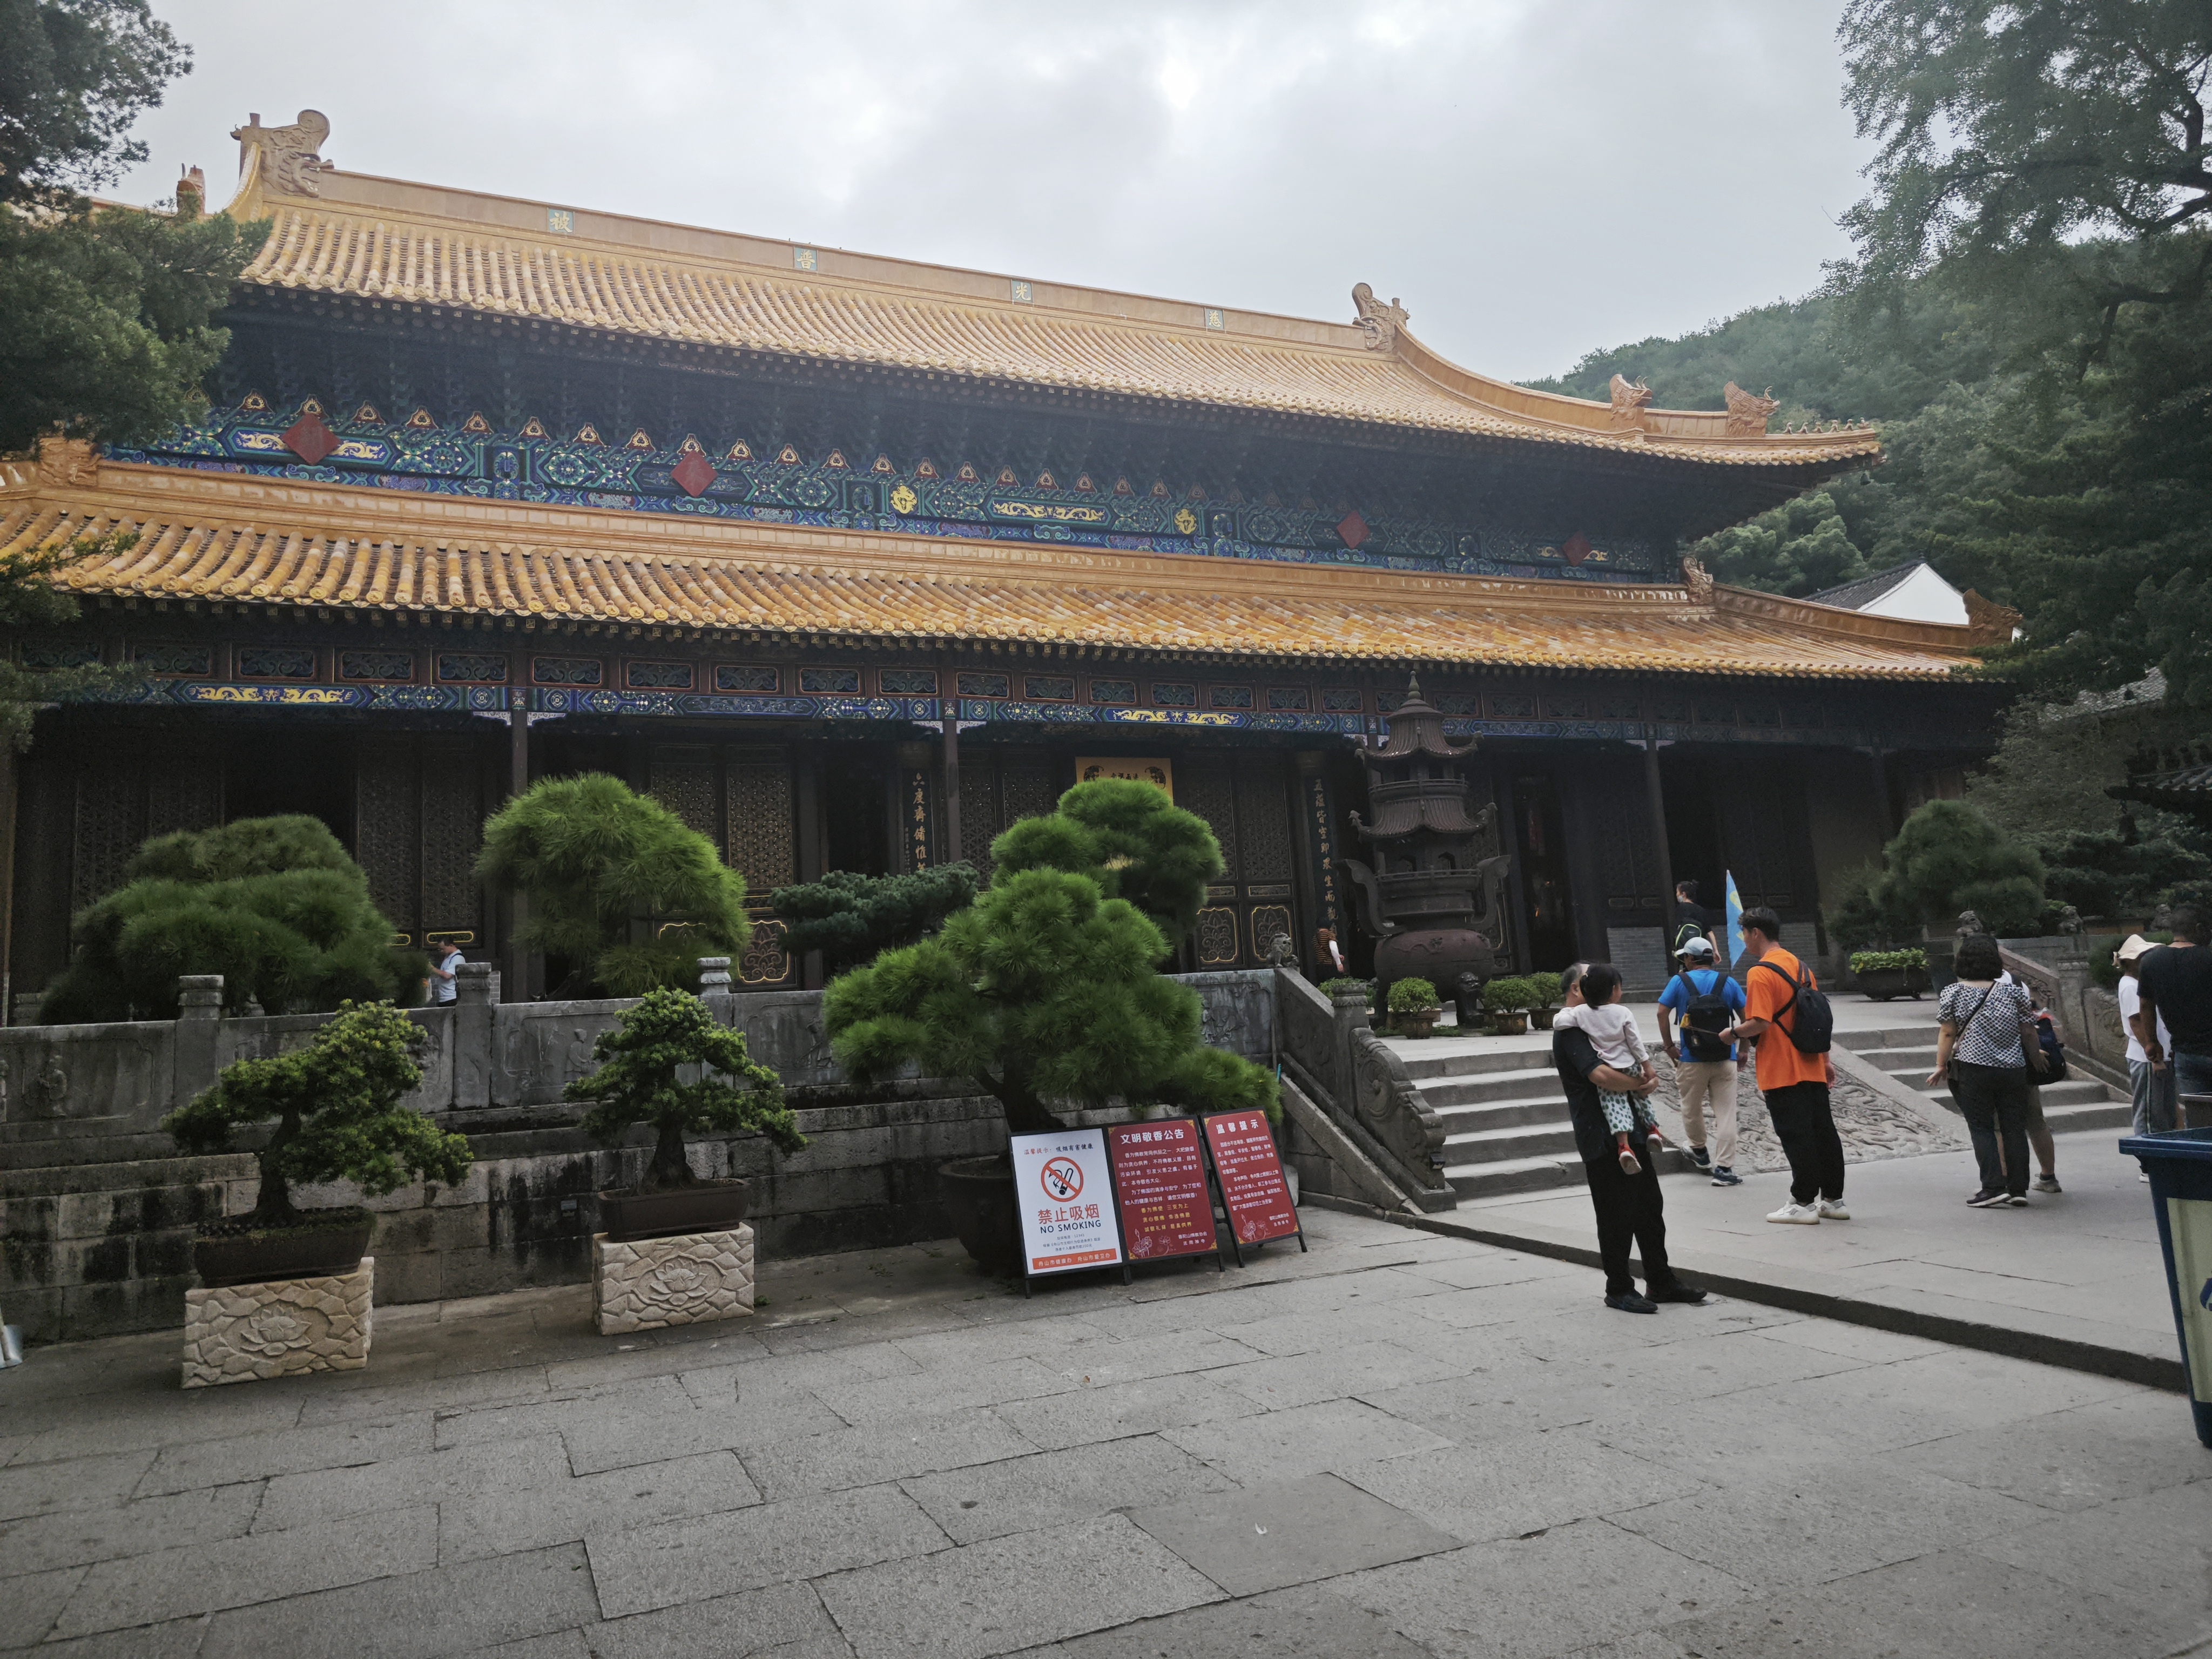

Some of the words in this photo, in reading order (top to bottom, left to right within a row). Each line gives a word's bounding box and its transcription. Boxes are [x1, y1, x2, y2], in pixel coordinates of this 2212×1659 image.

[550, 212, 572, 233] 被
[797, 250, 815, 269] 普
[1015, 282, 1031, 300] 光
[1209, 311, 1221, 327] 慈
[1216, 1119, 1259, 1135] 温馨提示
[1120, 1129, 1184, 1145] 文明敬香公告
[1037, 1204, 1100, 1225] 禁止吸烟
[1040, 1225, 1054, 1234] NO
[1058, 1219, 1101, 1232] SMOKING
[1038, 1258, 1072, 1267] 舟山市健康办
[1077, 1252, 1111, 1262] 舟山市爱卫办
